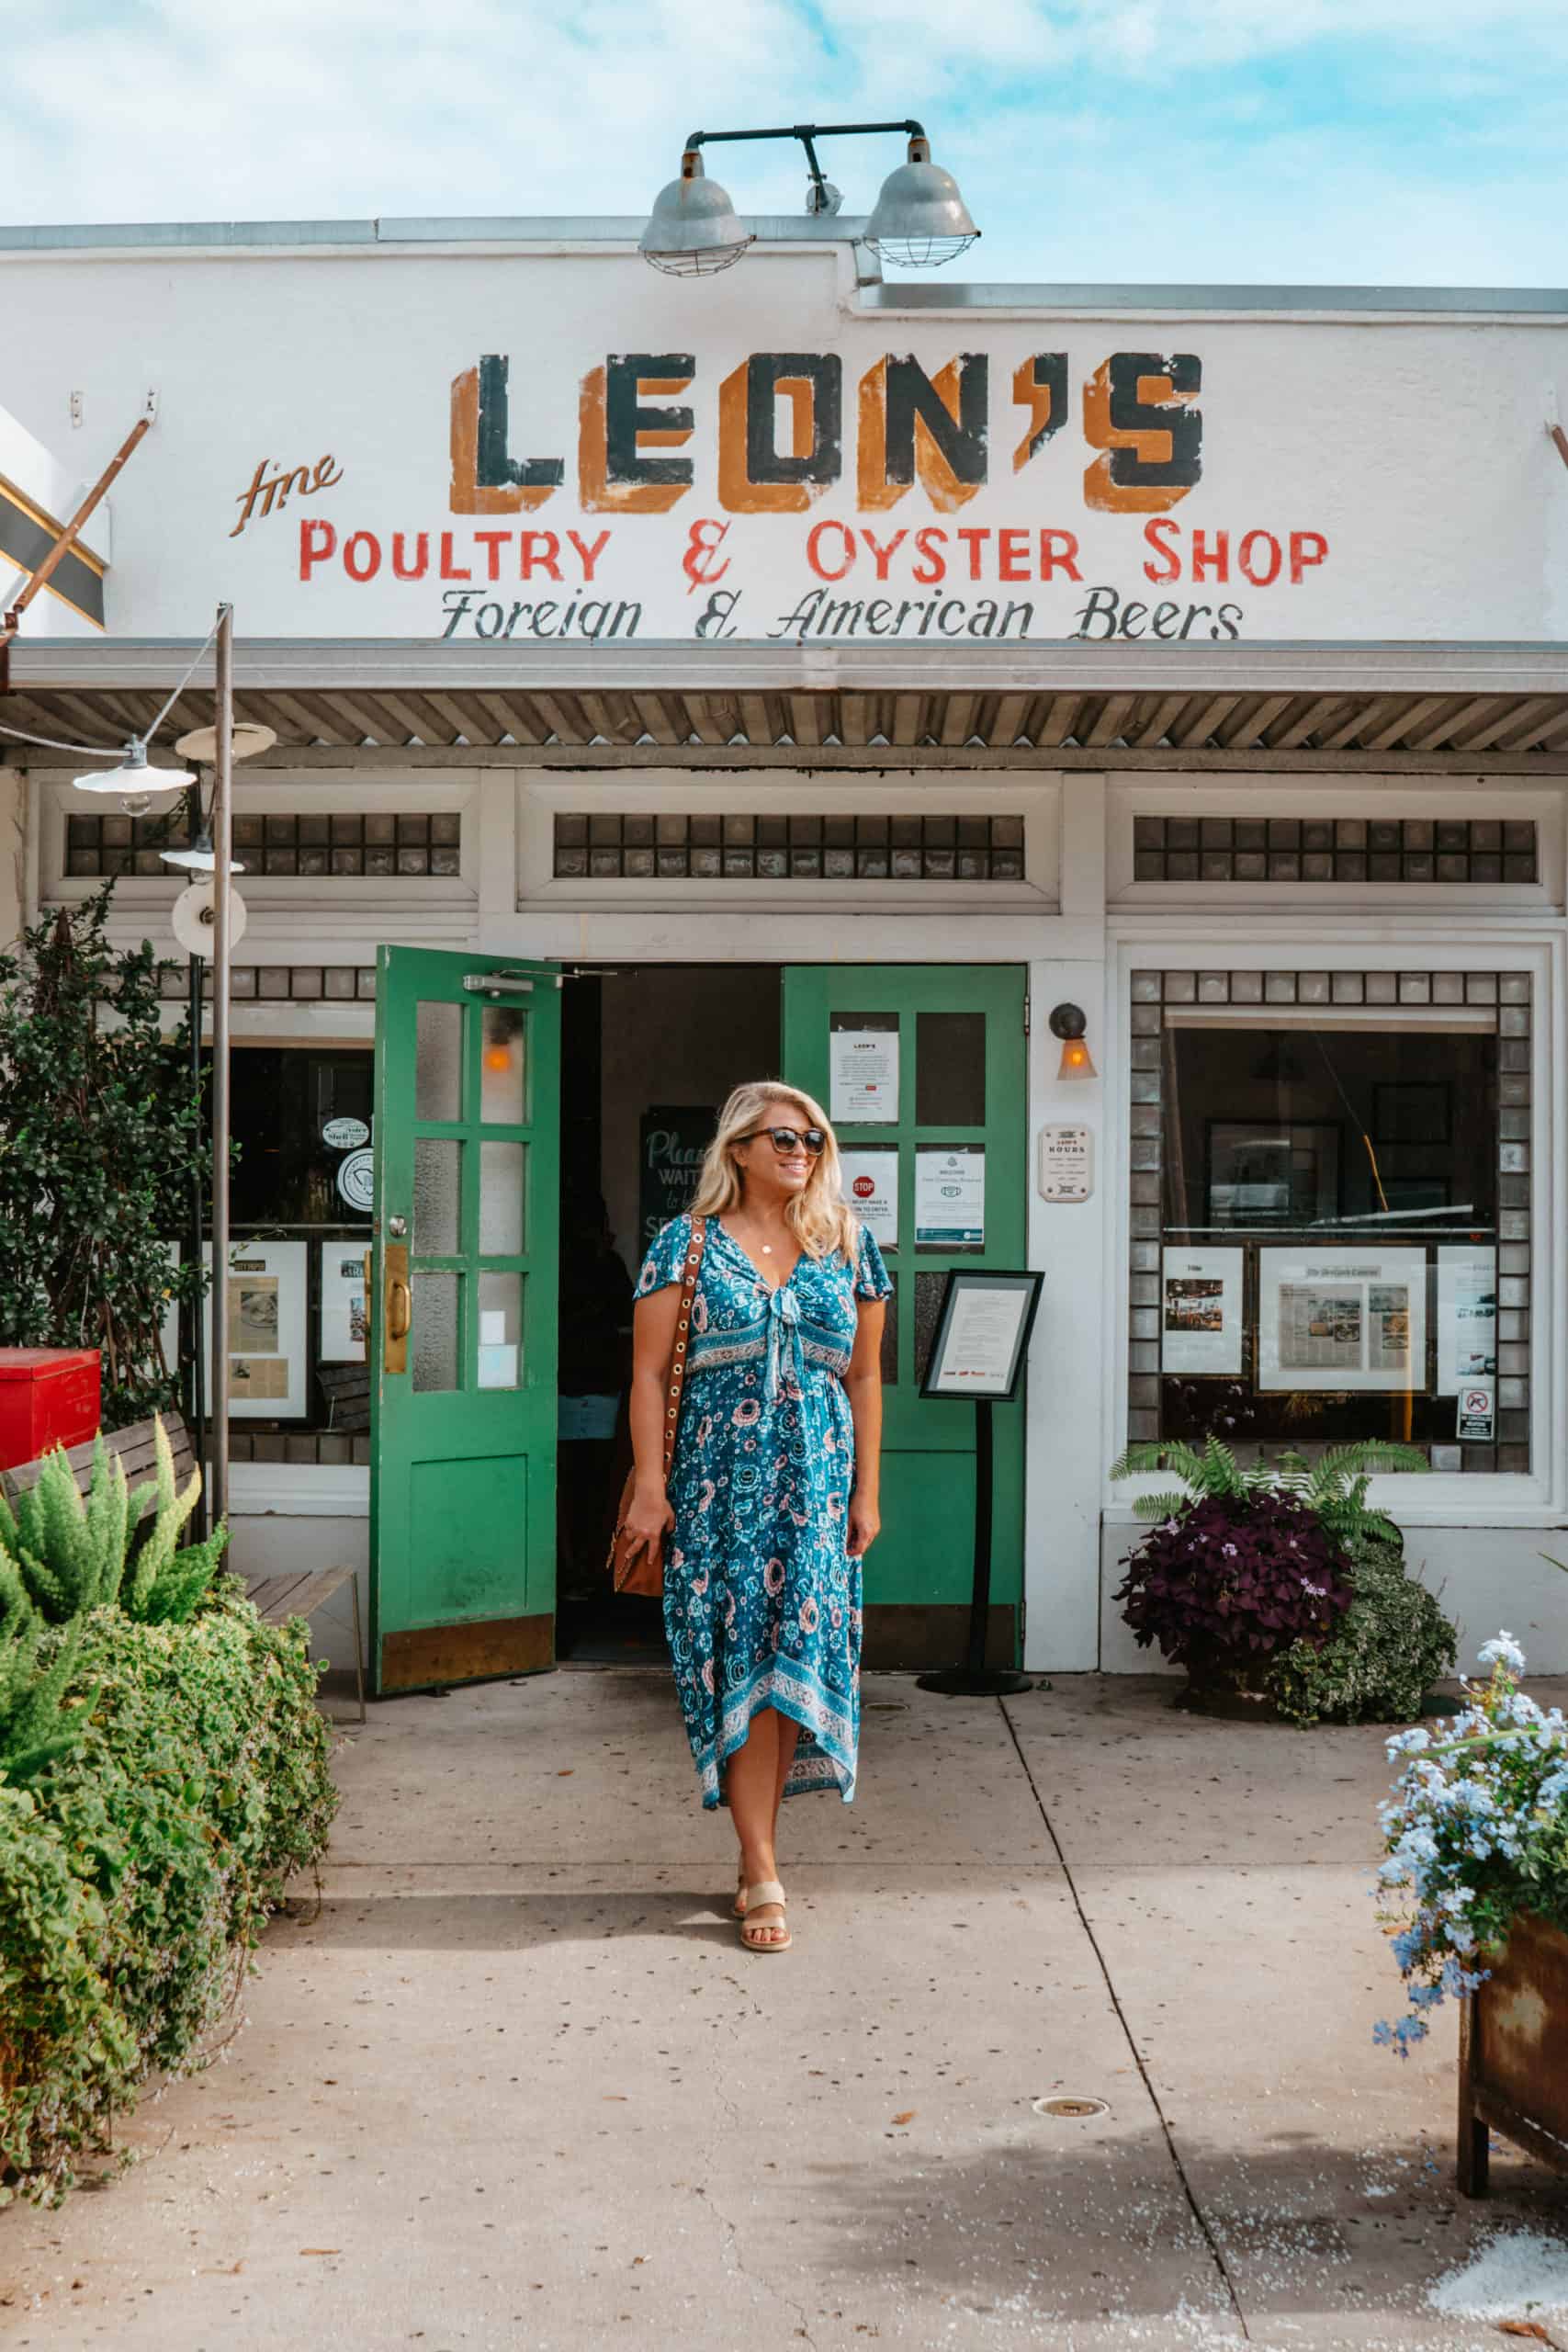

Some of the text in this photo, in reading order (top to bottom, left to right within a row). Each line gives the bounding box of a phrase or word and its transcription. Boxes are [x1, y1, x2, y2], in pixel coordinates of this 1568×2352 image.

[449, 353, 1202, 514] LEON'S
[229, 453, 344, 538] fine
[299, 517, 1329, 594] POULTRY & OYSTER SHOP
[442, 589, 641, 640] Foreign
[766, 587, 1034, 639] American
[1068, 586, 1244, 640] Beers
[854, 1182, 874, 1192] STOP
